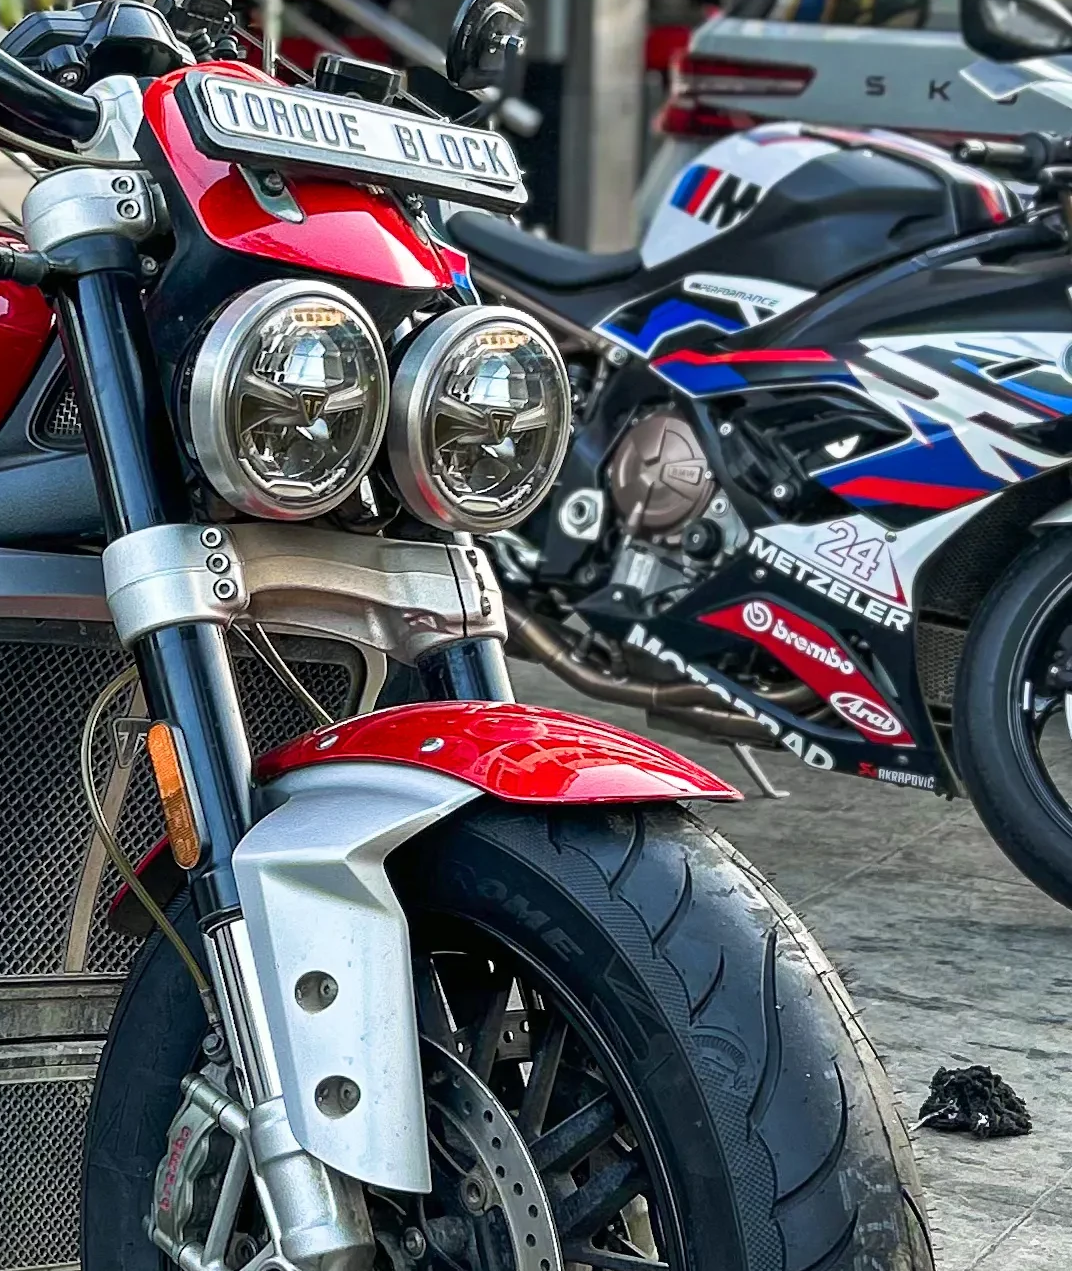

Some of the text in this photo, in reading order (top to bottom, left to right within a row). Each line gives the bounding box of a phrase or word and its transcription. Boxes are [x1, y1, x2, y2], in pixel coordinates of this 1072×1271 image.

[217, 85, 511, 177] TORQUE BLOCK
[700, 282, 780, 307] PERFORMANCE
[814, 520, 885, 581] 24
[748, 536, 911, 632] METZELER
[772, 619, 856, 675] brembo
[835, 696, 896, 731] Arai
[159, 1125, 192, 1211] brembo
